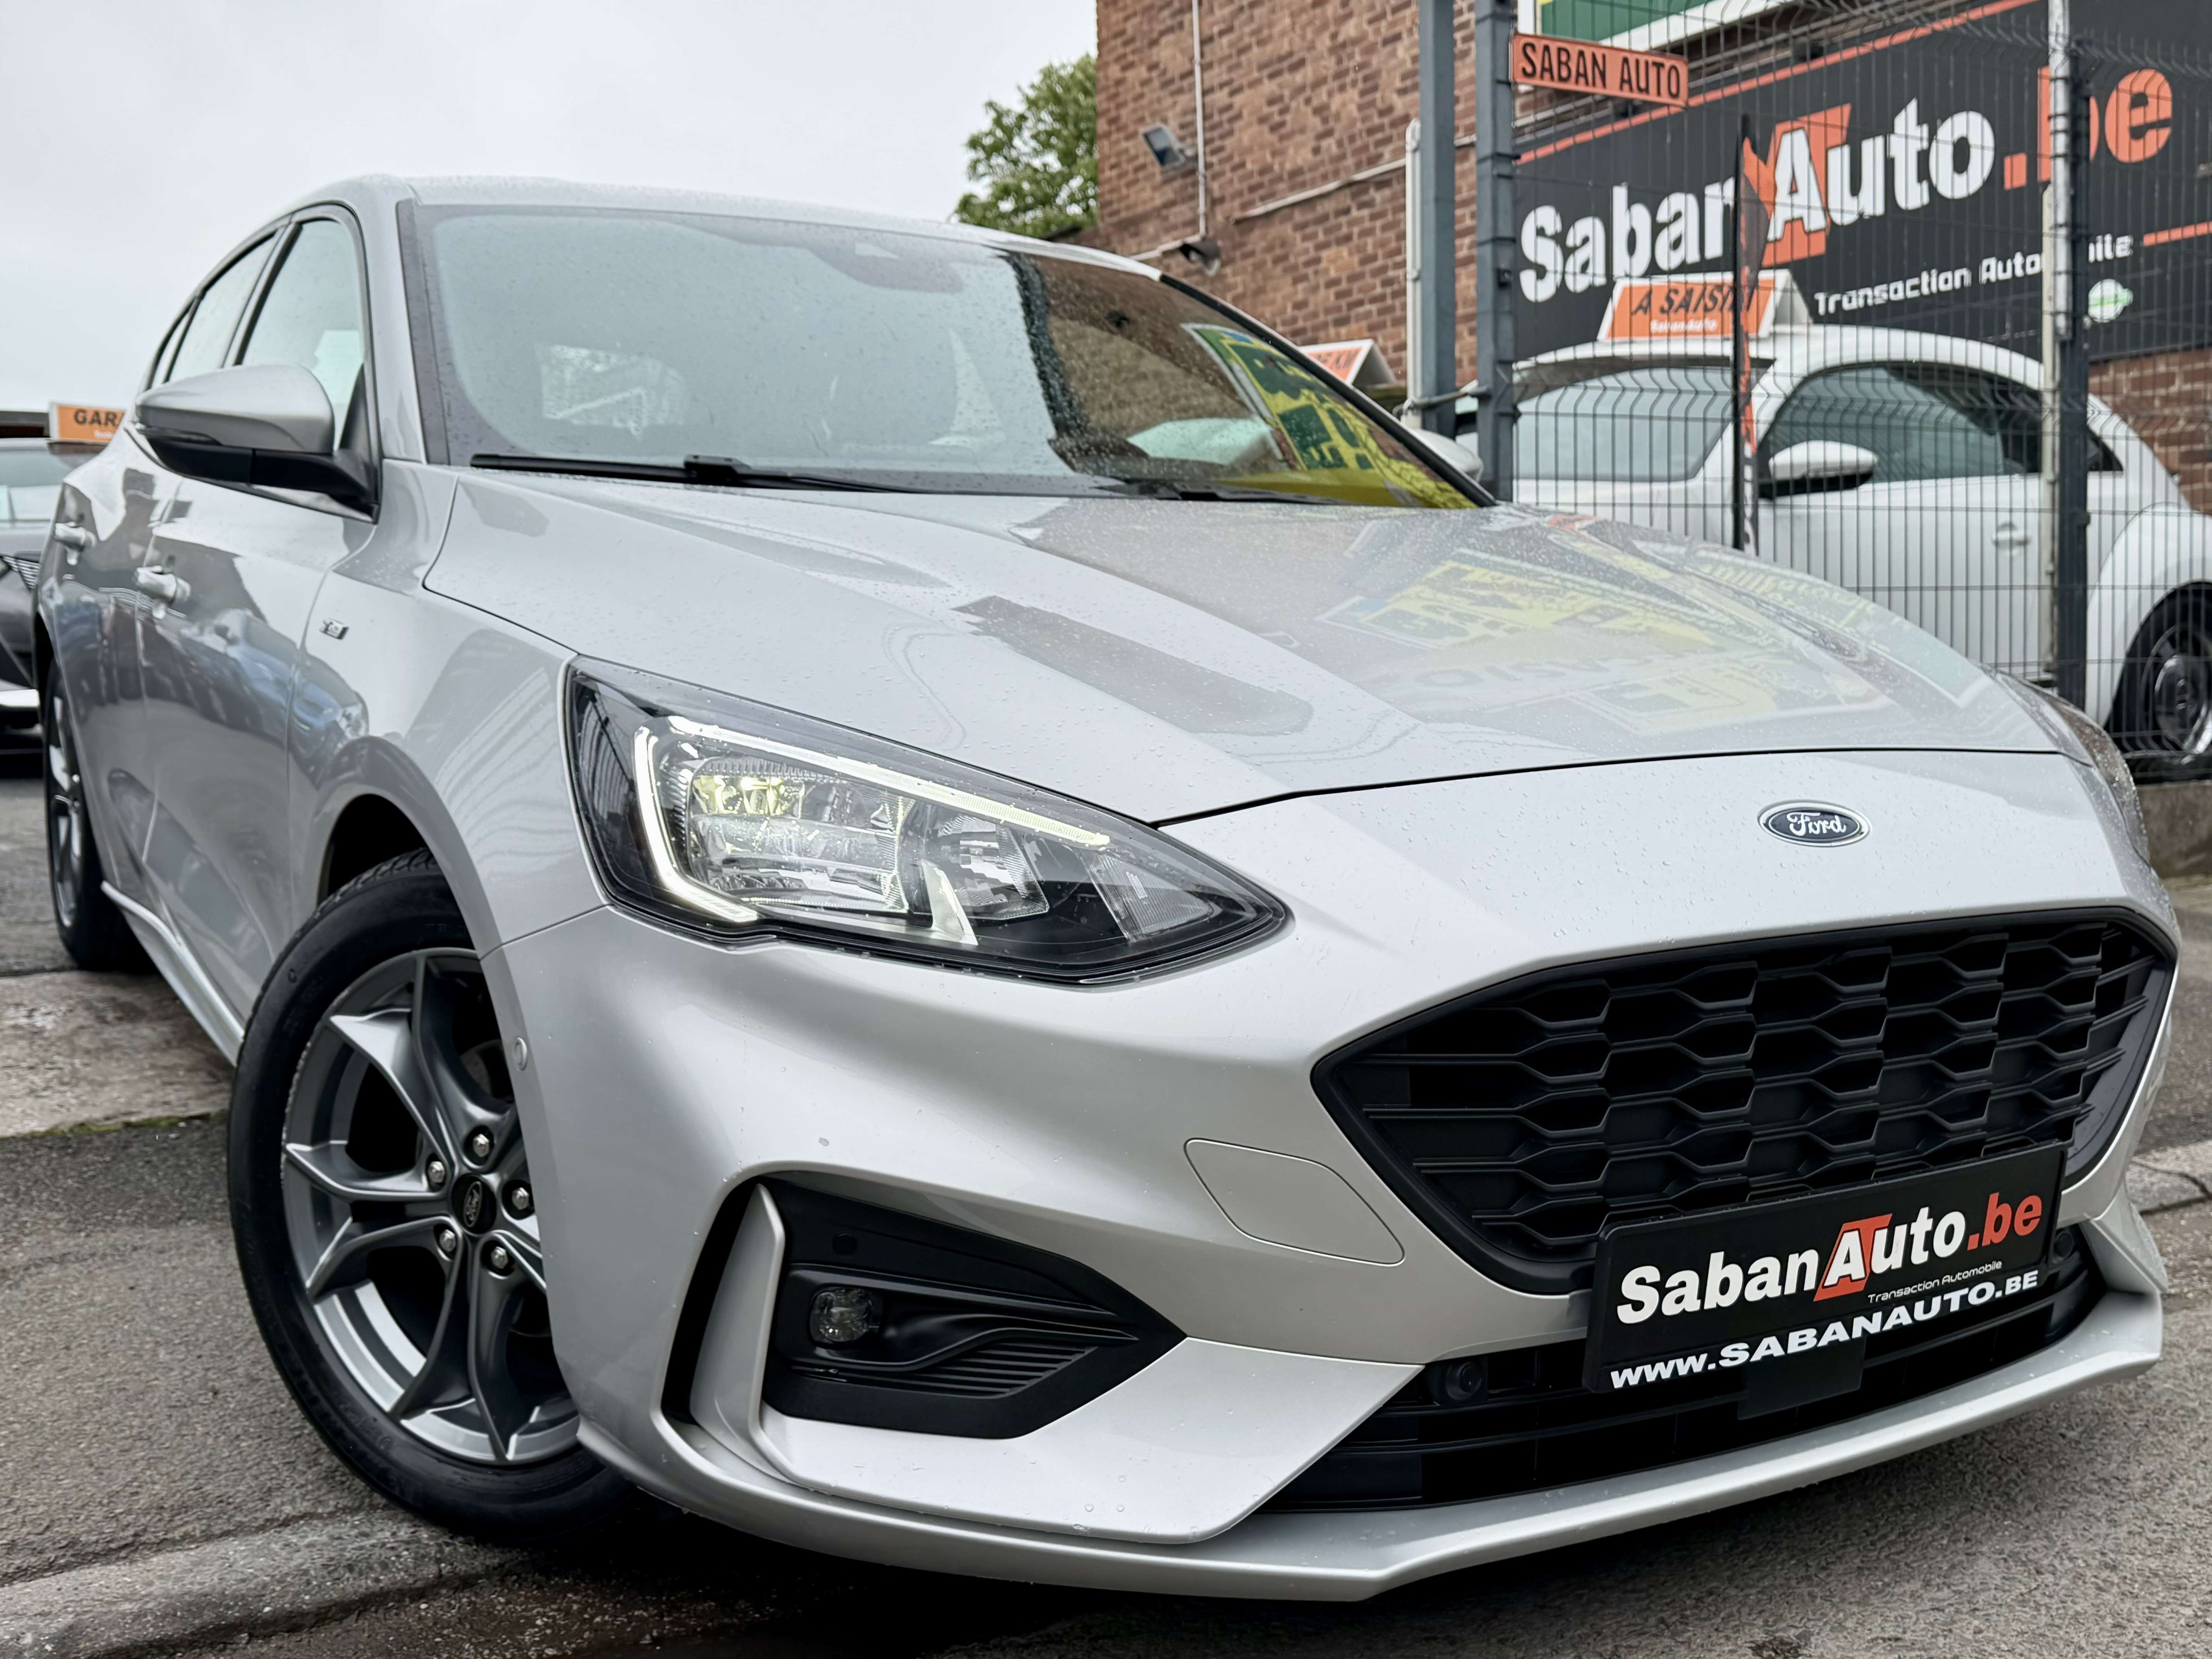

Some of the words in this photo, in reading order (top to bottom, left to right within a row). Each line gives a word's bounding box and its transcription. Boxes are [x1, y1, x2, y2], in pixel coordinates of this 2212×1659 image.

[1522, 43, 1607, 89] SABAN
[1620, 56, 1680, 98] AUTO
[1814, 267, 1972, 316] Transaction
[1979, 234, 2133, 284] Autoile
[1631, 288, 1652, 315] A
[1660, 284, 1734, 314] SAISI
[74, 409, 124, 426] GAR
[1786, 812, 1846, 836] Ford
[1868, 1279, 1940, 1304] Transaction
[1942, 1261, 2002, 1285] Automobile
